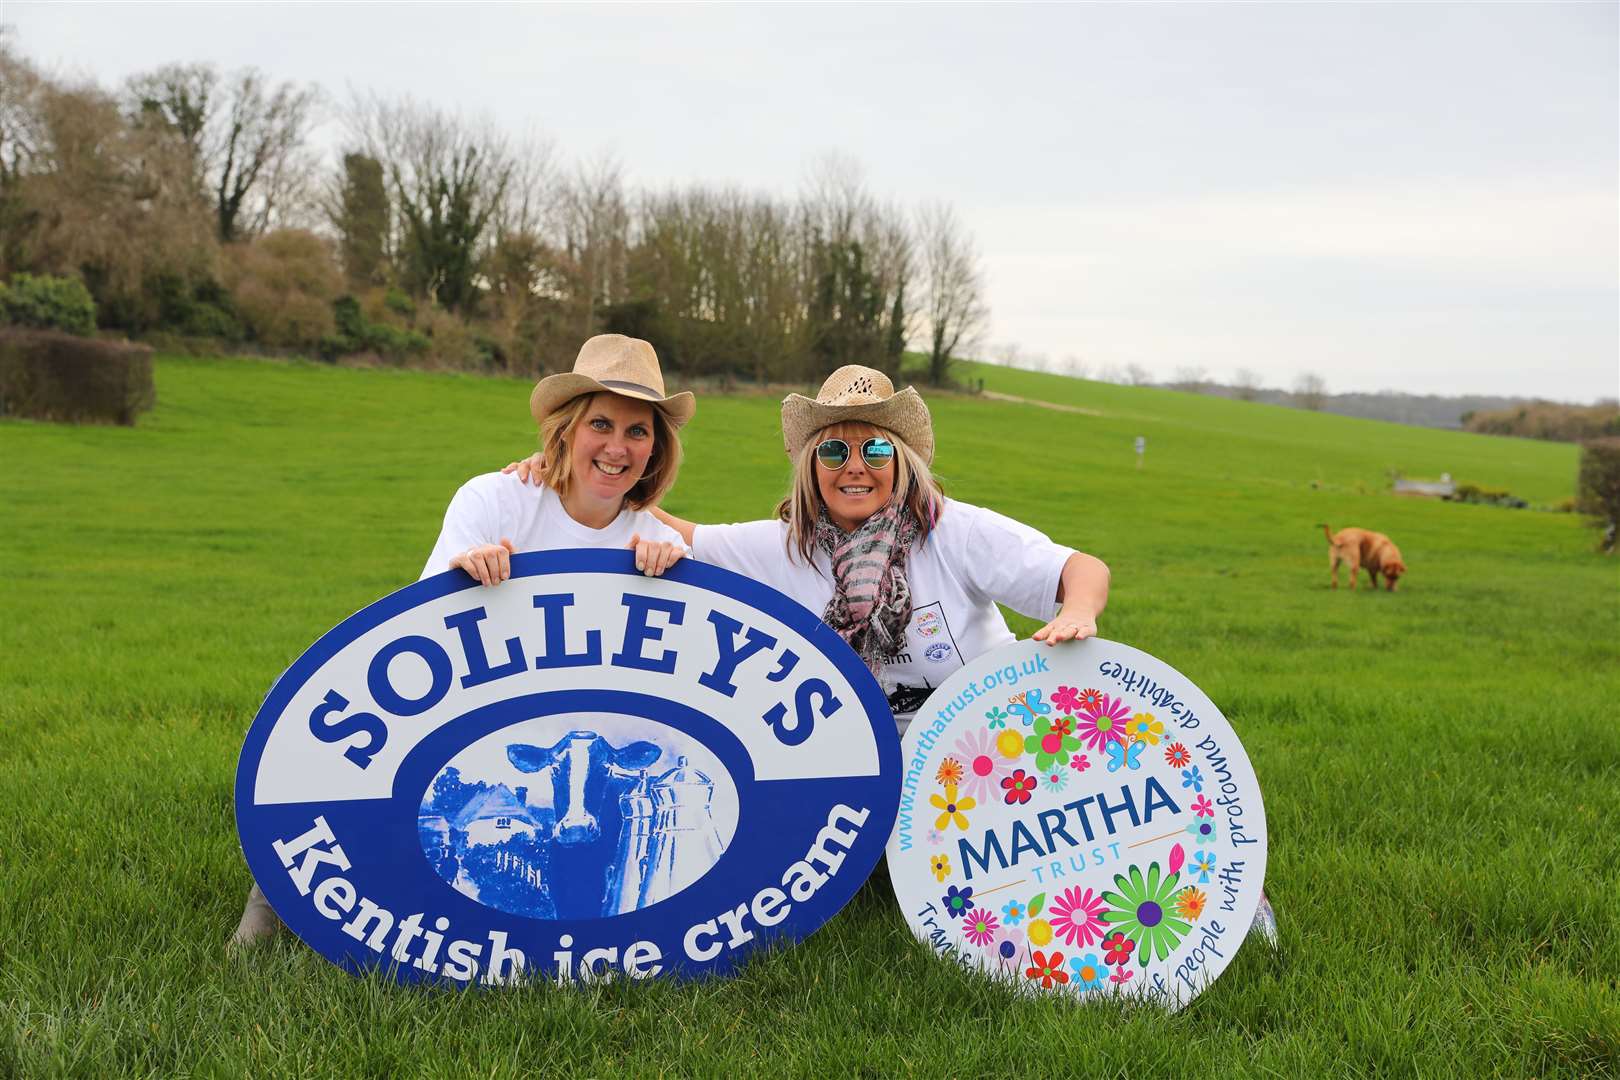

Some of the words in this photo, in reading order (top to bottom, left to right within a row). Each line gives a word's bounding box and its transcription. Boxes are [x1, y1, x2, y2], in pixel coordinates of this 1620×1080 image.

[309, 592, 842, 770] SOLLEY'S
[1099, 661, 1201, 729] disabilities
[900, 653, 1050, 852] www.marthatrust.org.uk
[1195, 734, 1258, 848] profound
[957, 776, 1182, 880] MARTHA
[1031, 842, 1121, 884] TRUST
[272, 816, 525, 987] Kentish
[553, 934, 663, 988] ice
[683, 802, 871, 963] cream
[1219, 861, 1246, 912] with
[1174, 922, 1226, 994] people
